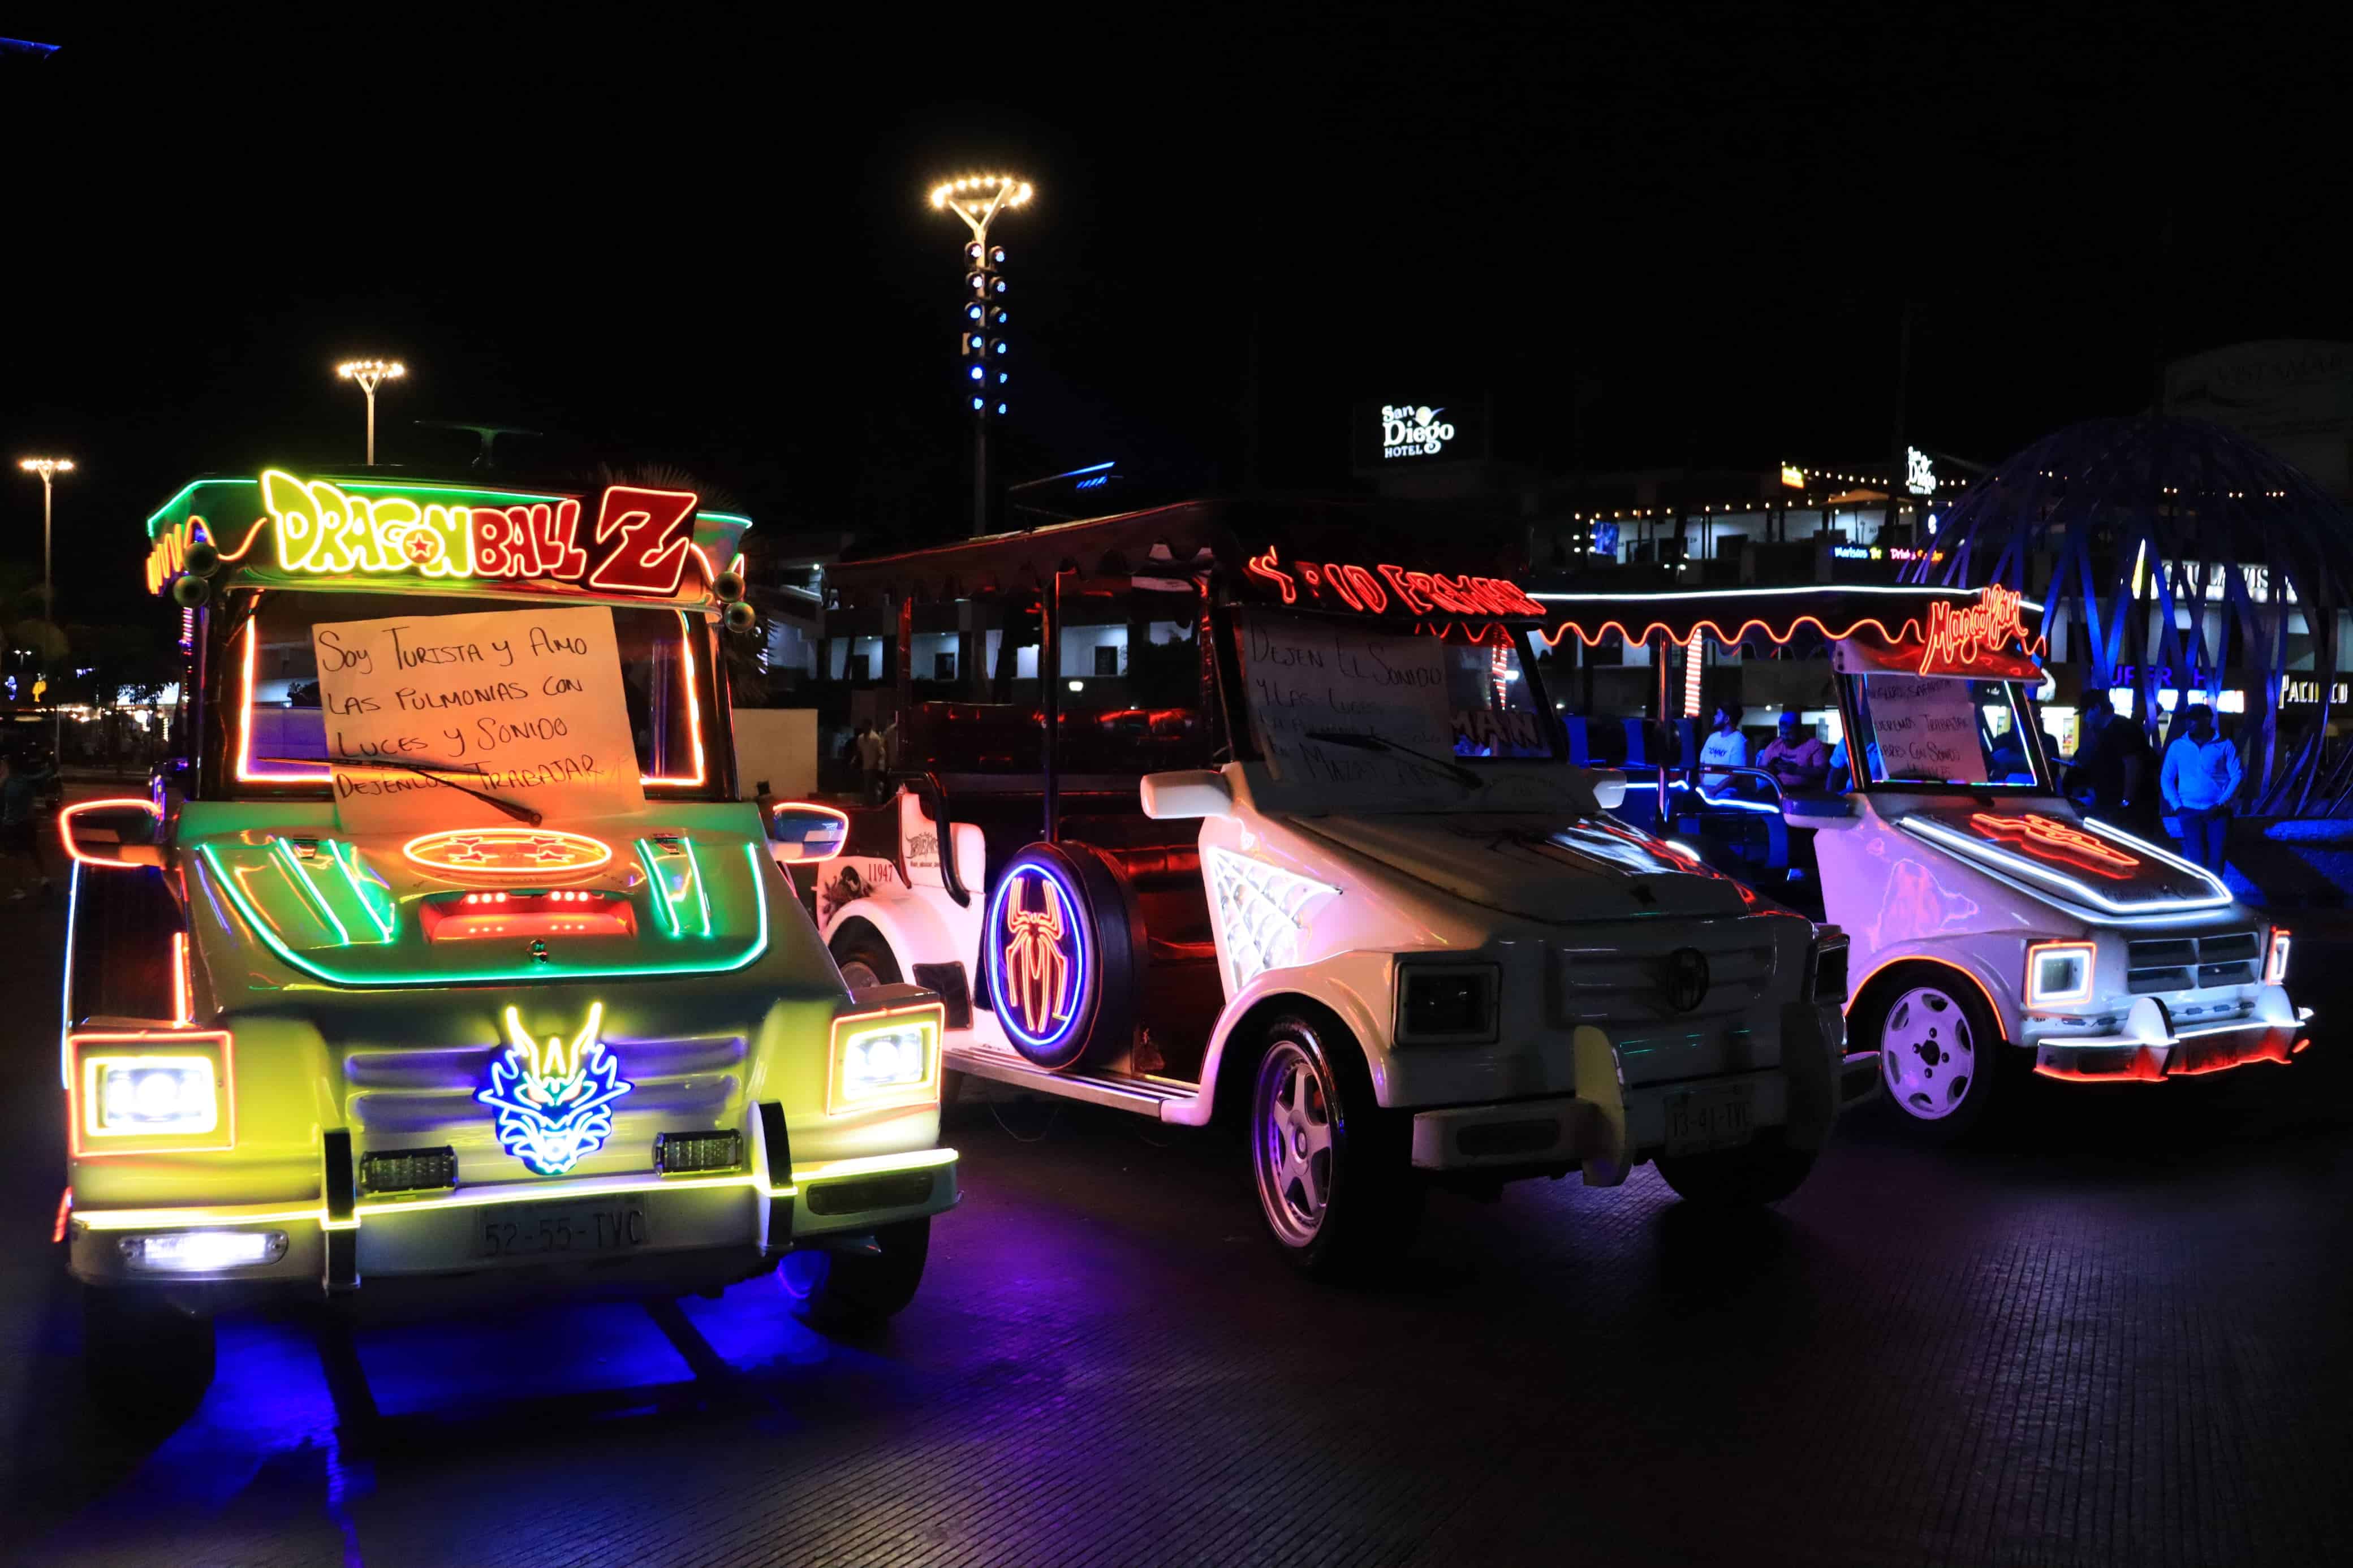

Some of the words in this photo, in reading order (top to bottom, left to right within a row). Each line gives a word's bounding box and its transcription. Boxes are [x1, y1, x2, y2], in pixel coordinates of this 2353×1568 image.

[1381, 405, 1415, 422] San
[1382, 420, 1455, 455] Diego
[1384, 444, 1423, 459] HOTEL
[259, 469, 476, 577] DRAGON
[473, 499, 587, 578] BALL
[588, 486, 698, 593] Z
[329, 693, 381, 715] LAS
[396, 683, 528, 711] PULMONIAS
[544, 676, 583, 696] CON
[337, 733, 428, 758] LUCES
[477, 718, 567, 750] SONIDO
[868, 863, 893, 883] 11947
[485, 1210, 644, 1257] 52-55-TVC
